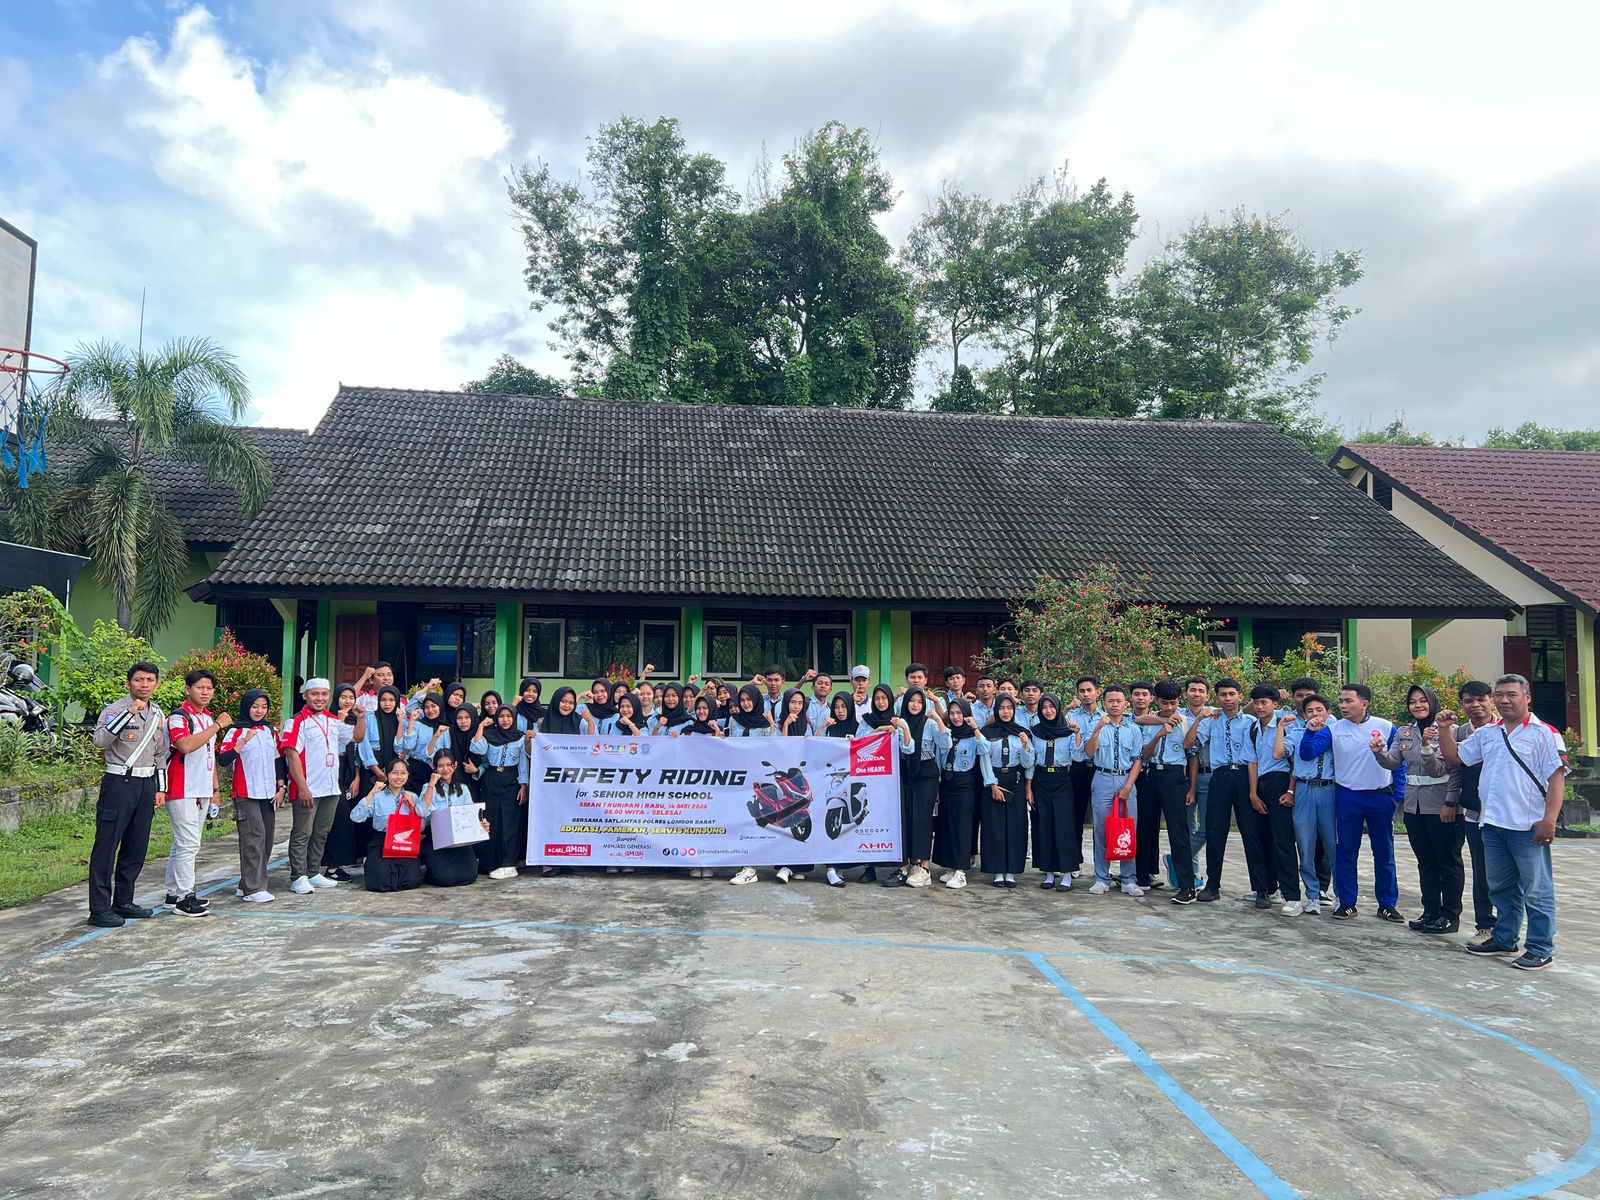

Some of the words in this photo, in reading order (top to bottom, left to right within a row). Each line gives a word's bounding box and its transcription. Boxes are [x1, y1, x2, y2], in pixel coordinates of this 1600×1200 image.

[543, 767, 652, 784] SAFETY
[658, 769, 748, 786] RIDING
[576, 788, 588, 798] for
[592, 790, 634, 798] SENIOR
[636, 791, 665, 799] HIGH
[668, 792, 714, 800] SCHOOL
[560, 825, 602, 834] EDUKASI,
[602, 826, 649, 834] PAMERAN,
